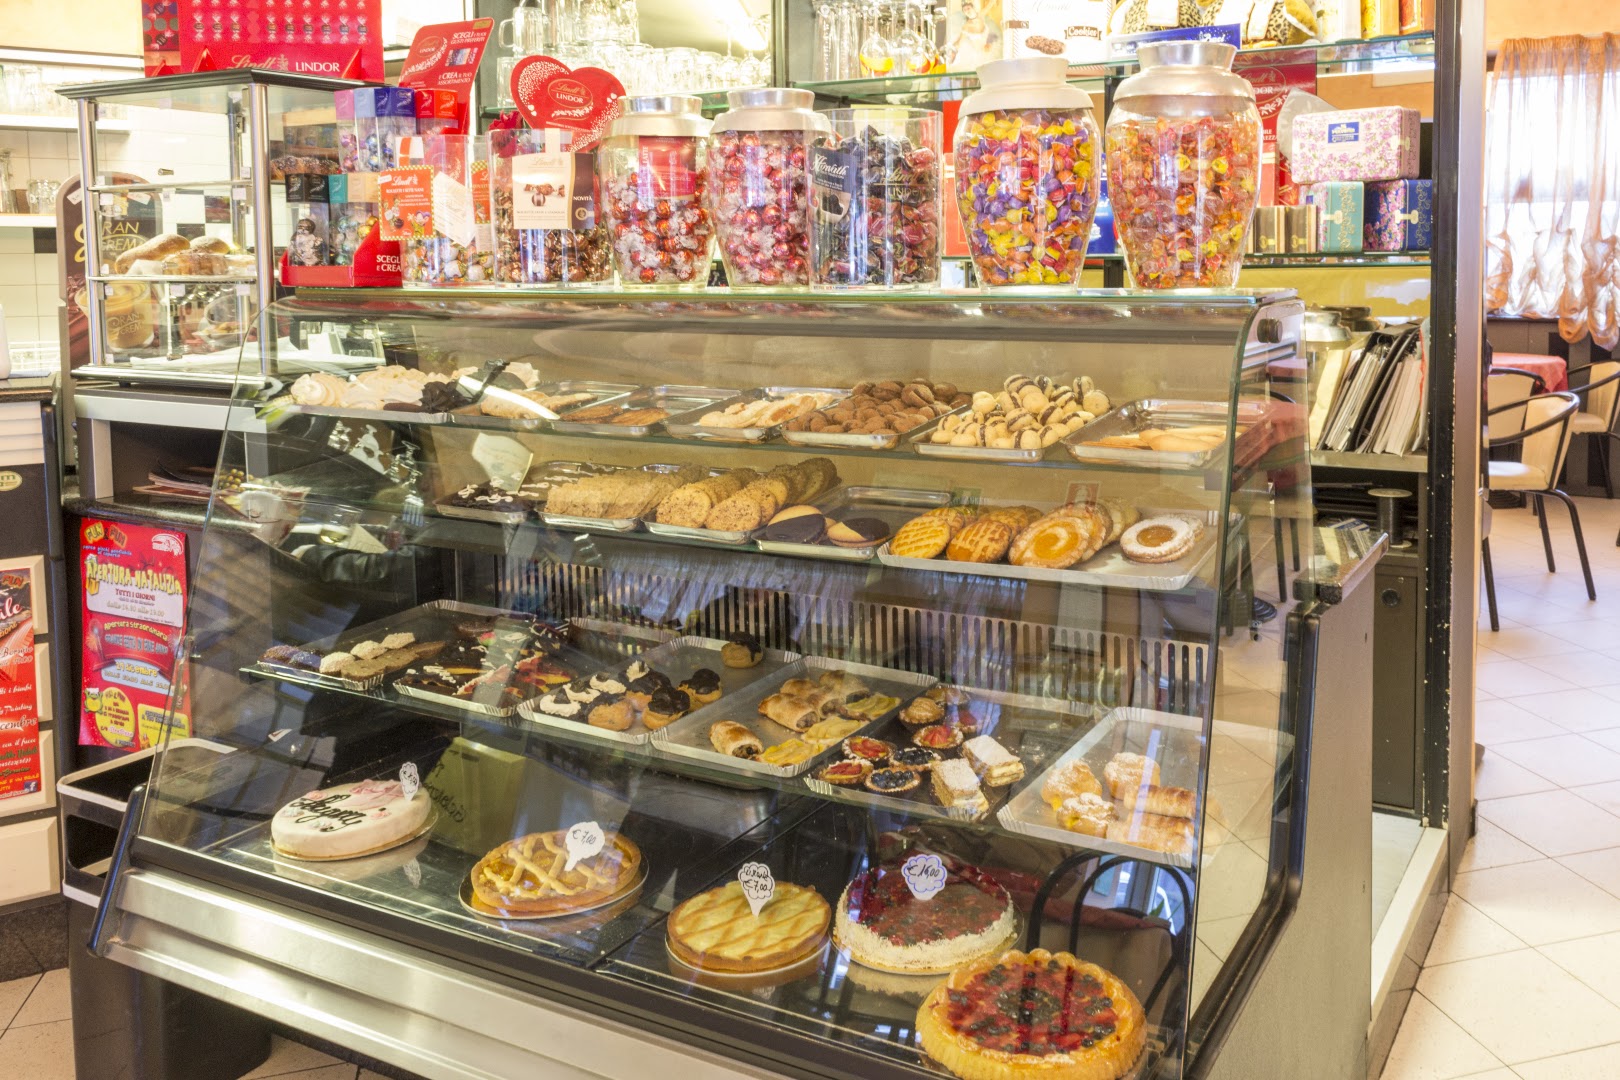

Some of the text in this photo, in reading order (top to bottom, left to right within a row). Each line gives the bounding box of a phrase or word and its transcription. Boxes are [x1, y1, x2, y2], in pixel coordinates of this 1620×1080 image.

[1068, 26, 1097, 37] Cookies
[227, 54, 277, 69] Lindt
[295, 61, 340, 72] LINDOR
[555, 83, 580, 93] Lindt
[556, 92, 584, 104] LINDOR
[376, 255, 400, 263] SCEGL
[381, 264, 401, 272] CREA
[86, 562, 183, 595] APERTURA NATALIZIA
[115, 588, 131, 596] TUTTI
[0, 715, 37, 730] cembre
